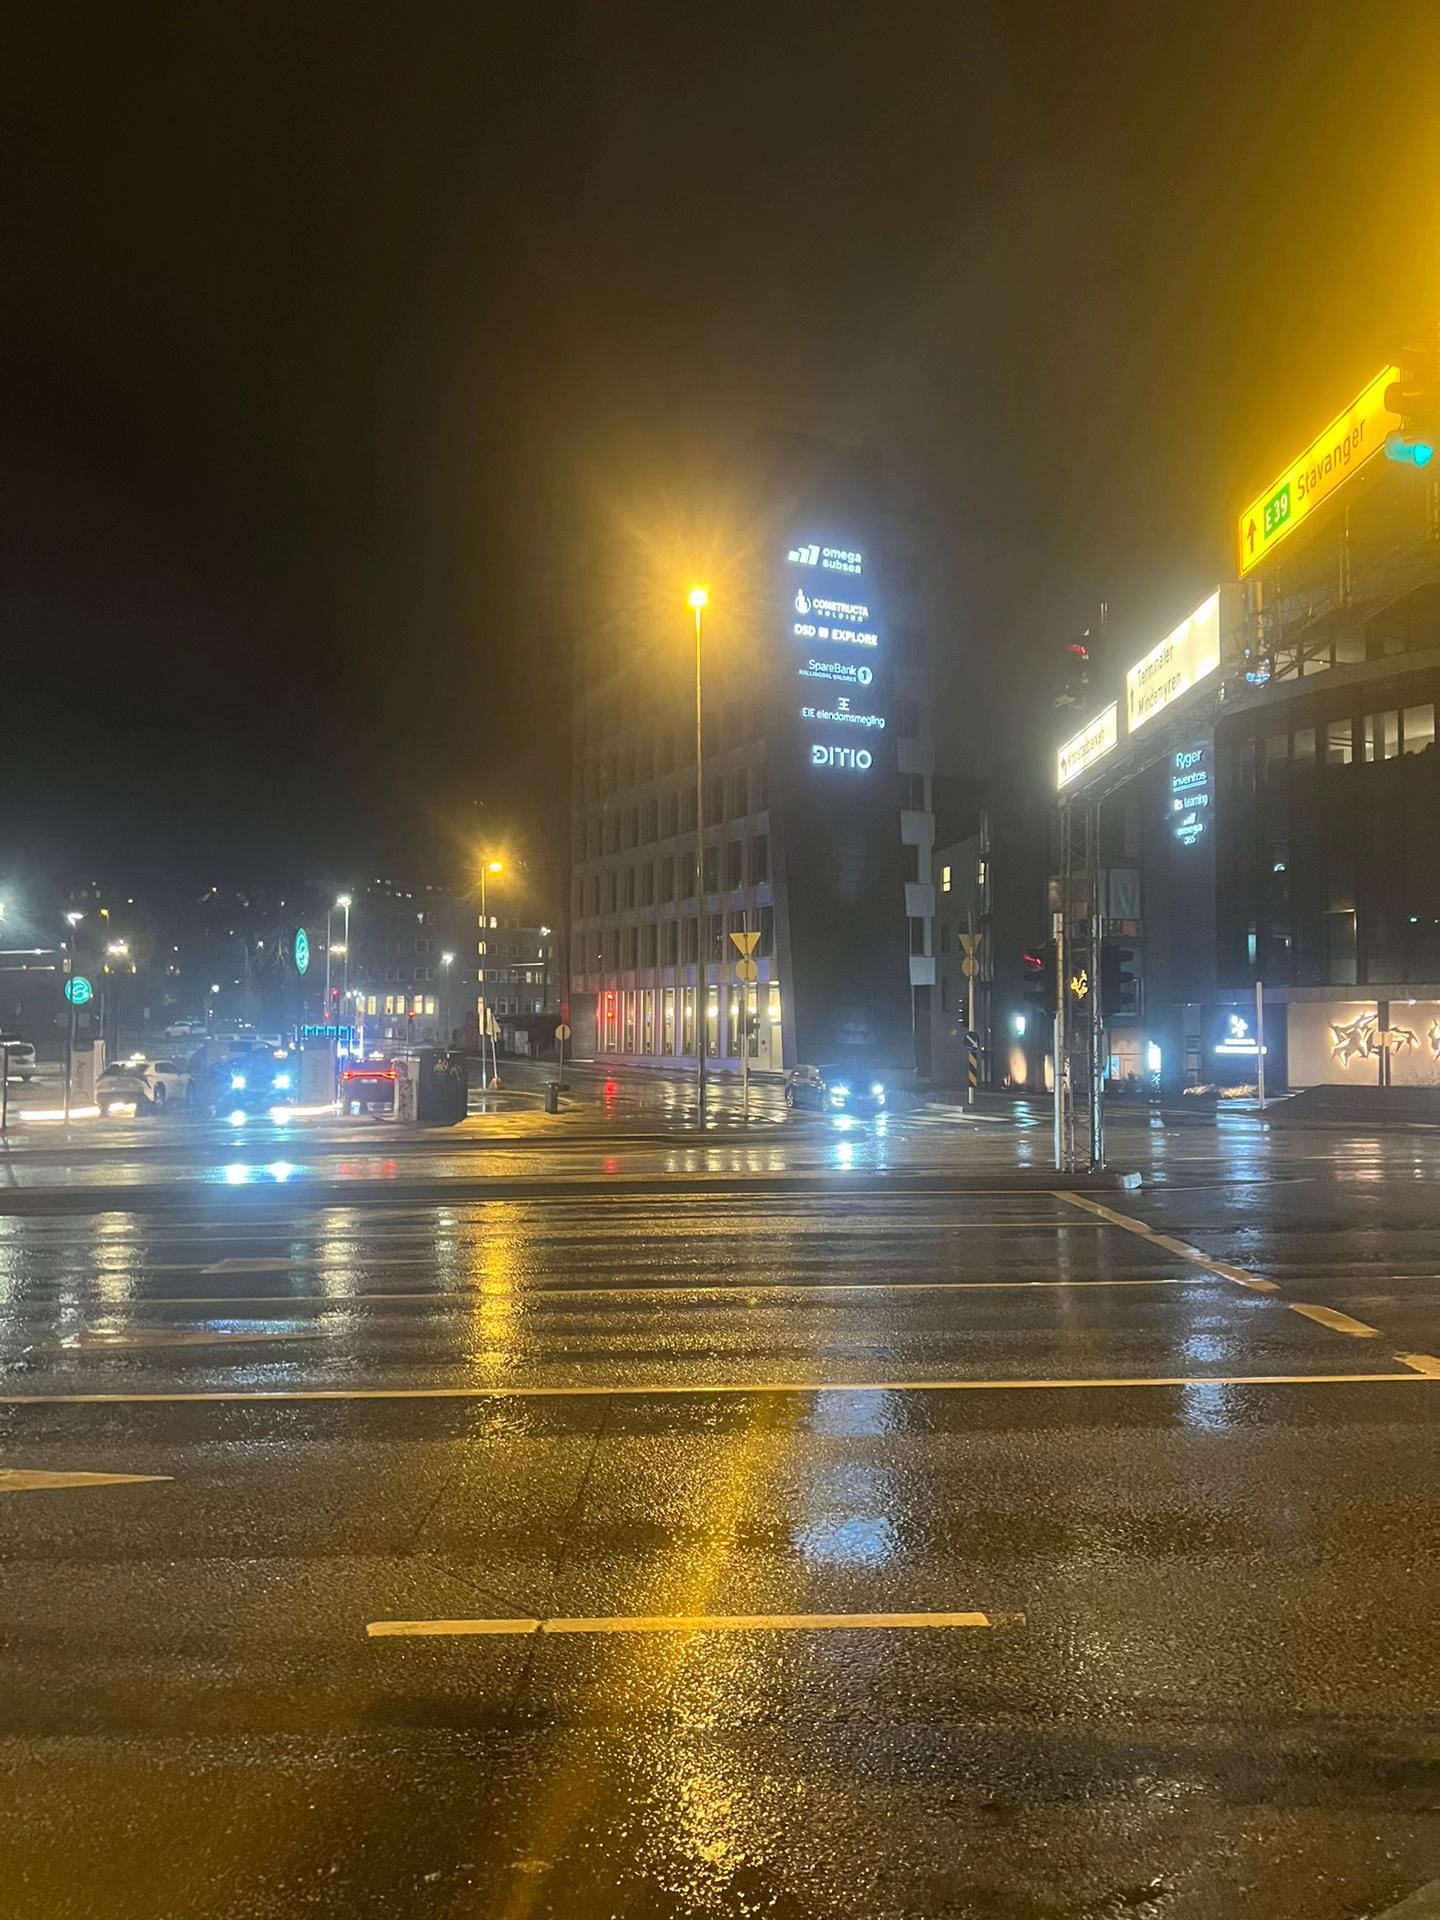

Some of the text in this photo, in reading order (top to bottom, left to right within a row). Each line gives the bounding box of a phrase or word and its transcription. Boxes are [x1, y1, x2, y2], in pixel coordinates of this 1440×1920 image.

[1297, 419, 1365, 501] Stavanger
[822, 547, 862, 563] omega
[822, 558, 862, 574] subsea
[813, 598, 869, 617] CONSTRUCTA
[817, 610, 863, 622] HOLDING
[794, 623, 878, 646] DSD EXPLORE
[808, 659, 857, 676] SpareBank
[802, 707, 885, 728] EIE eiendomsmegling
[812, 744, 872, 769] DITIO
[1176, 750, 1202, 769] Ryger
